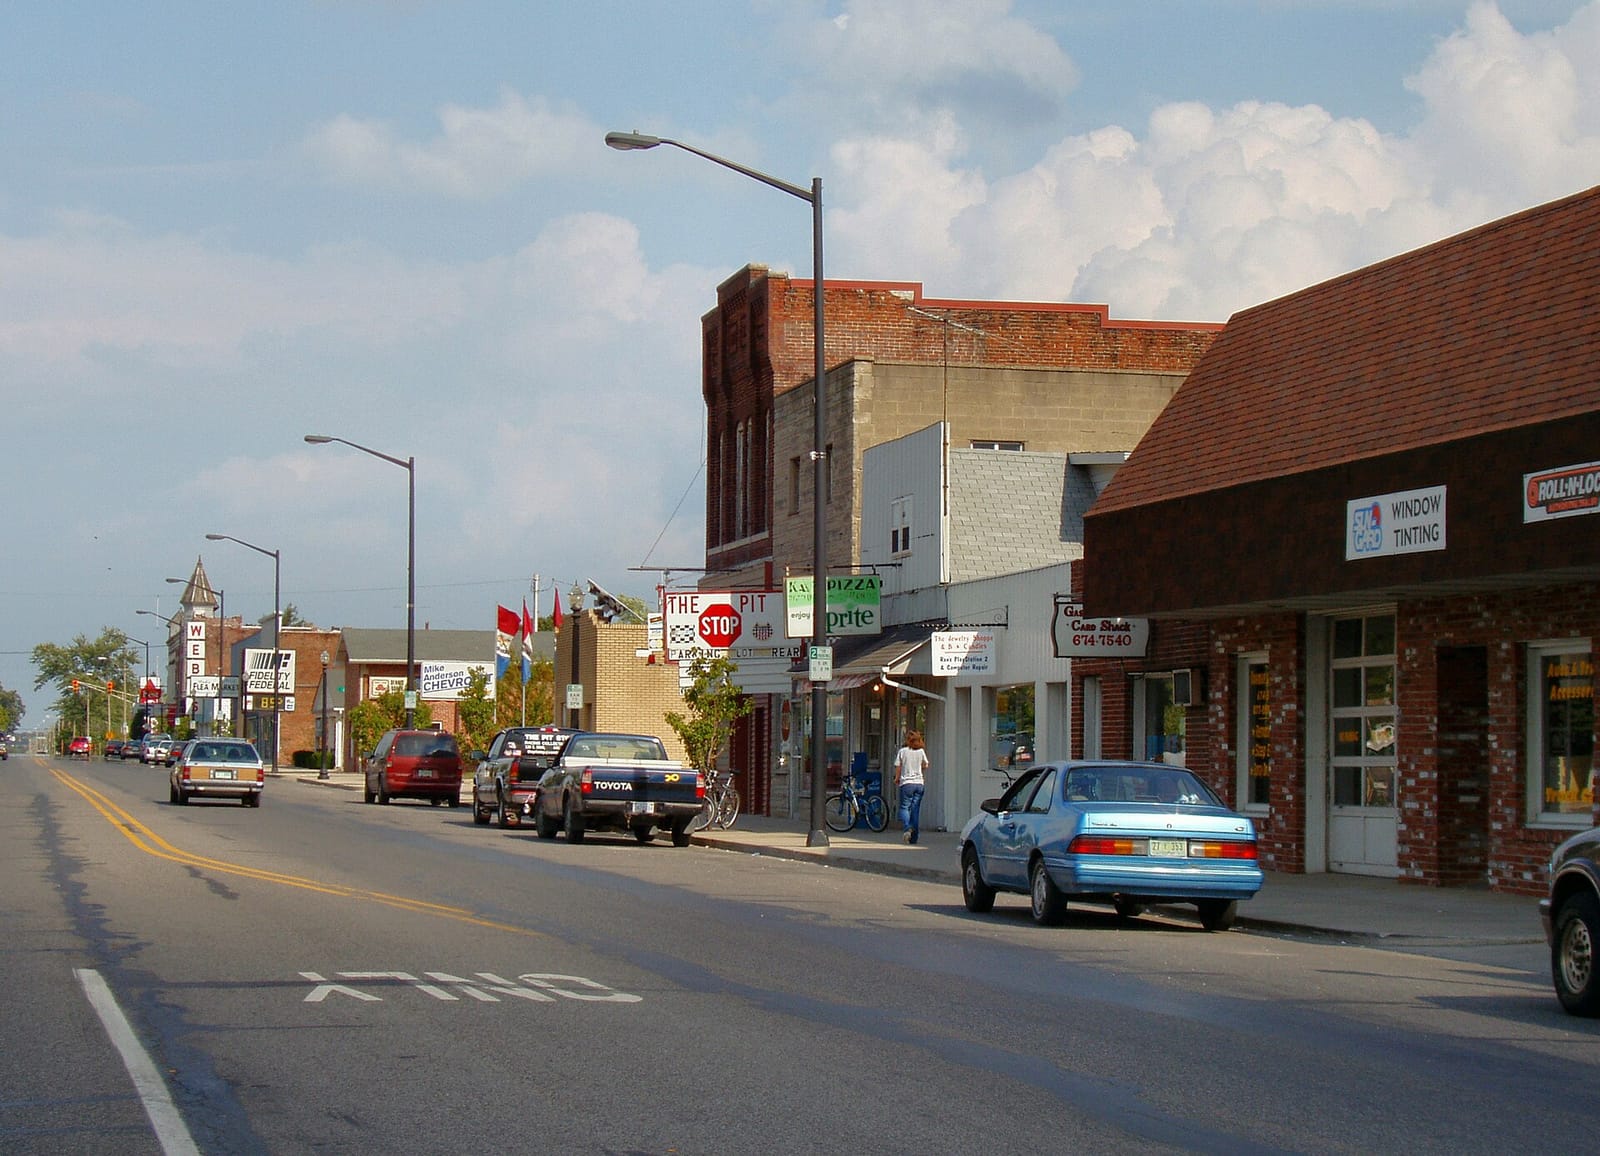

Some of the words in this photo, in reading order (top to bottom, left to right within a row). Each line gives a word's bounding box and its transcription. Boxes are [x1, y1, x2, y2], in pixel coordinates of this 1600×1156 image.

[1391, 494, 1441, 520] WINDOW
[1393, 523, 1440, 547] TINTING
[827, 579, 876, 591] PIZZA
[668, 595, 699, 614] THE
[740, 594, 767, 613] PIT
[790, 610, 811, 620] enjoy
[826, 607, 874, 633] prite
[701, 616, 740, 635] STOP
[670, 648, 721, 659] PARKING
[736, 648, 753, 657] LOT
[772, 647, 800, 657] REAR
[423, 665, 445, 674] Mike
[249, 671, 291, 681] FIDELTY
[423, 671, 464, 682] Anderson
[423, 673, 494, 691] CHEVROT
[193, 683, 209, 691] FLEA
[524, 733, 540, 741] THE
[593, 781, 633, 791] TOYOTA
[298, 970, 643, 1003] ONLY
